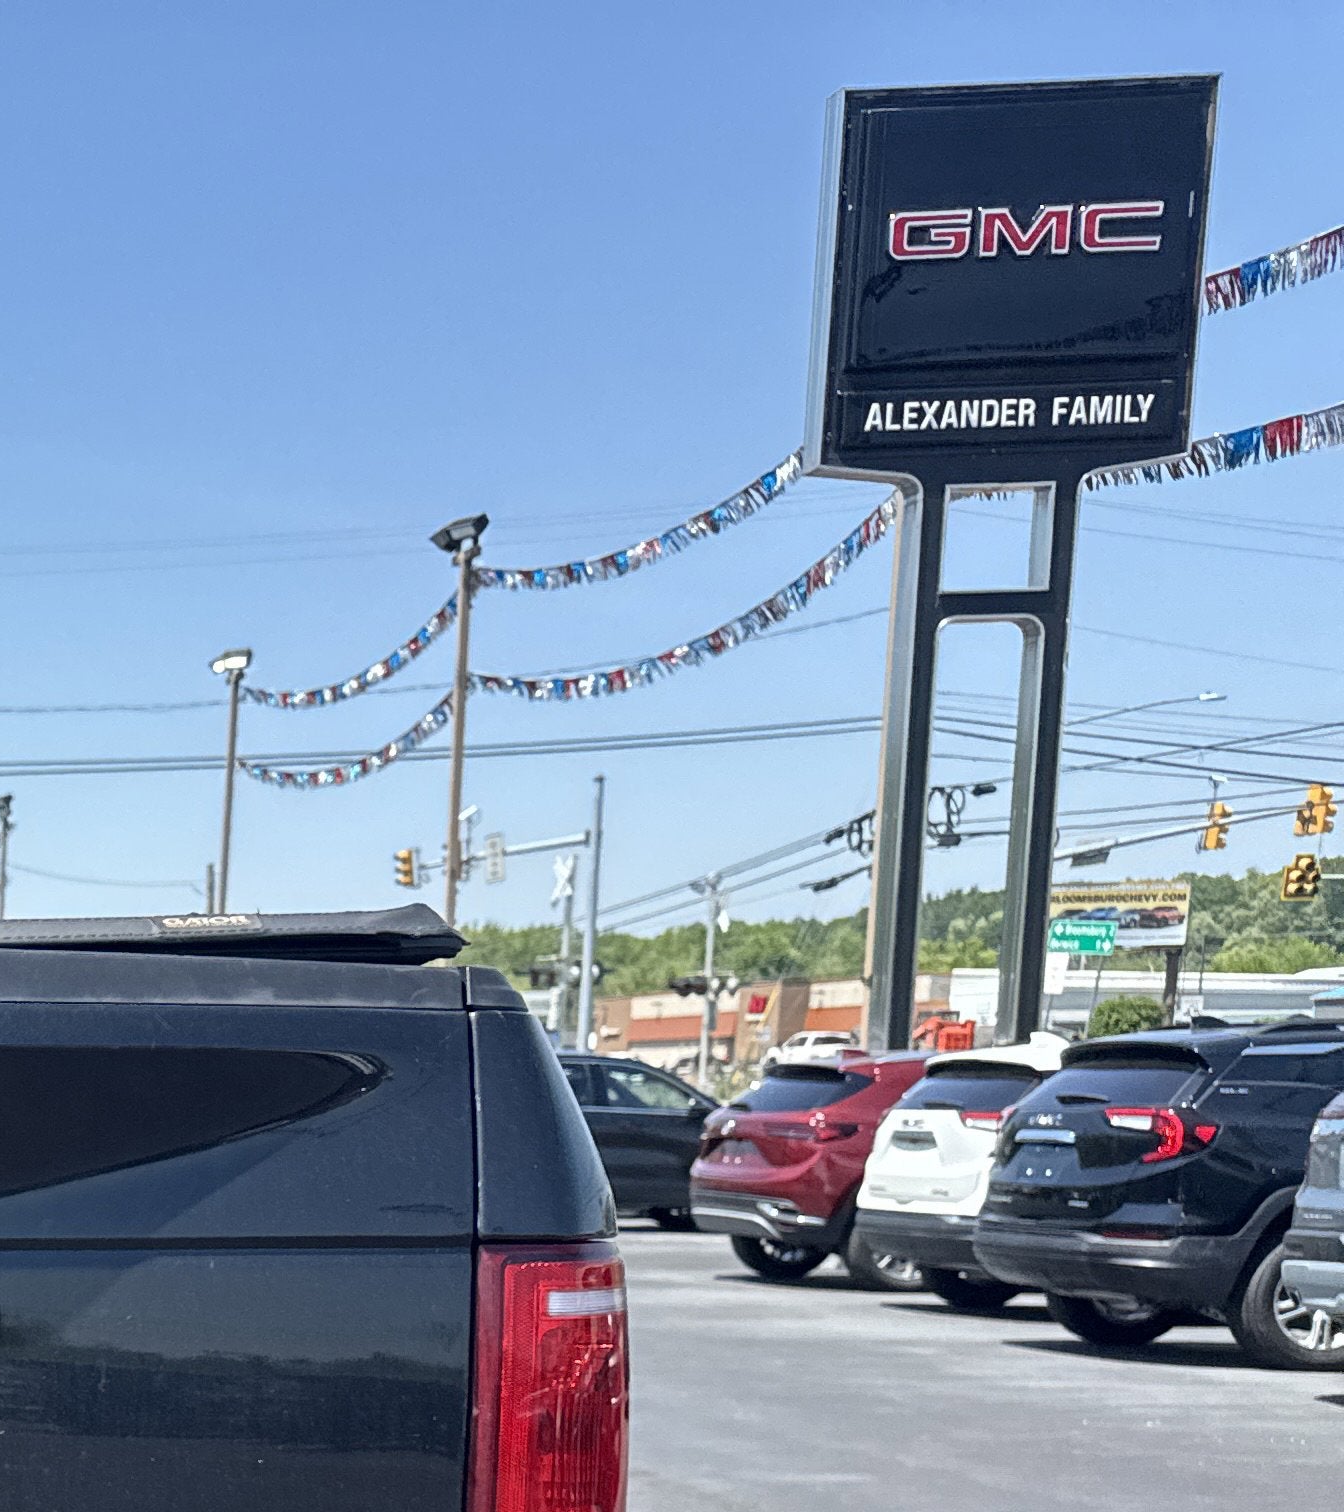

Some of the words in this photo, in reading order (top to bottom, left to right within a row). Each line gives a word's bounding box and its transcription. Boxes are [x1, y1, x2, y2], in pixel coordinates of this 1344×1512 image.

[887, 200, 1165, 261] GMC
[863, 398, 1036, 433] ALEXANDER
[1051, 393, 1155, 426] FAMILY
